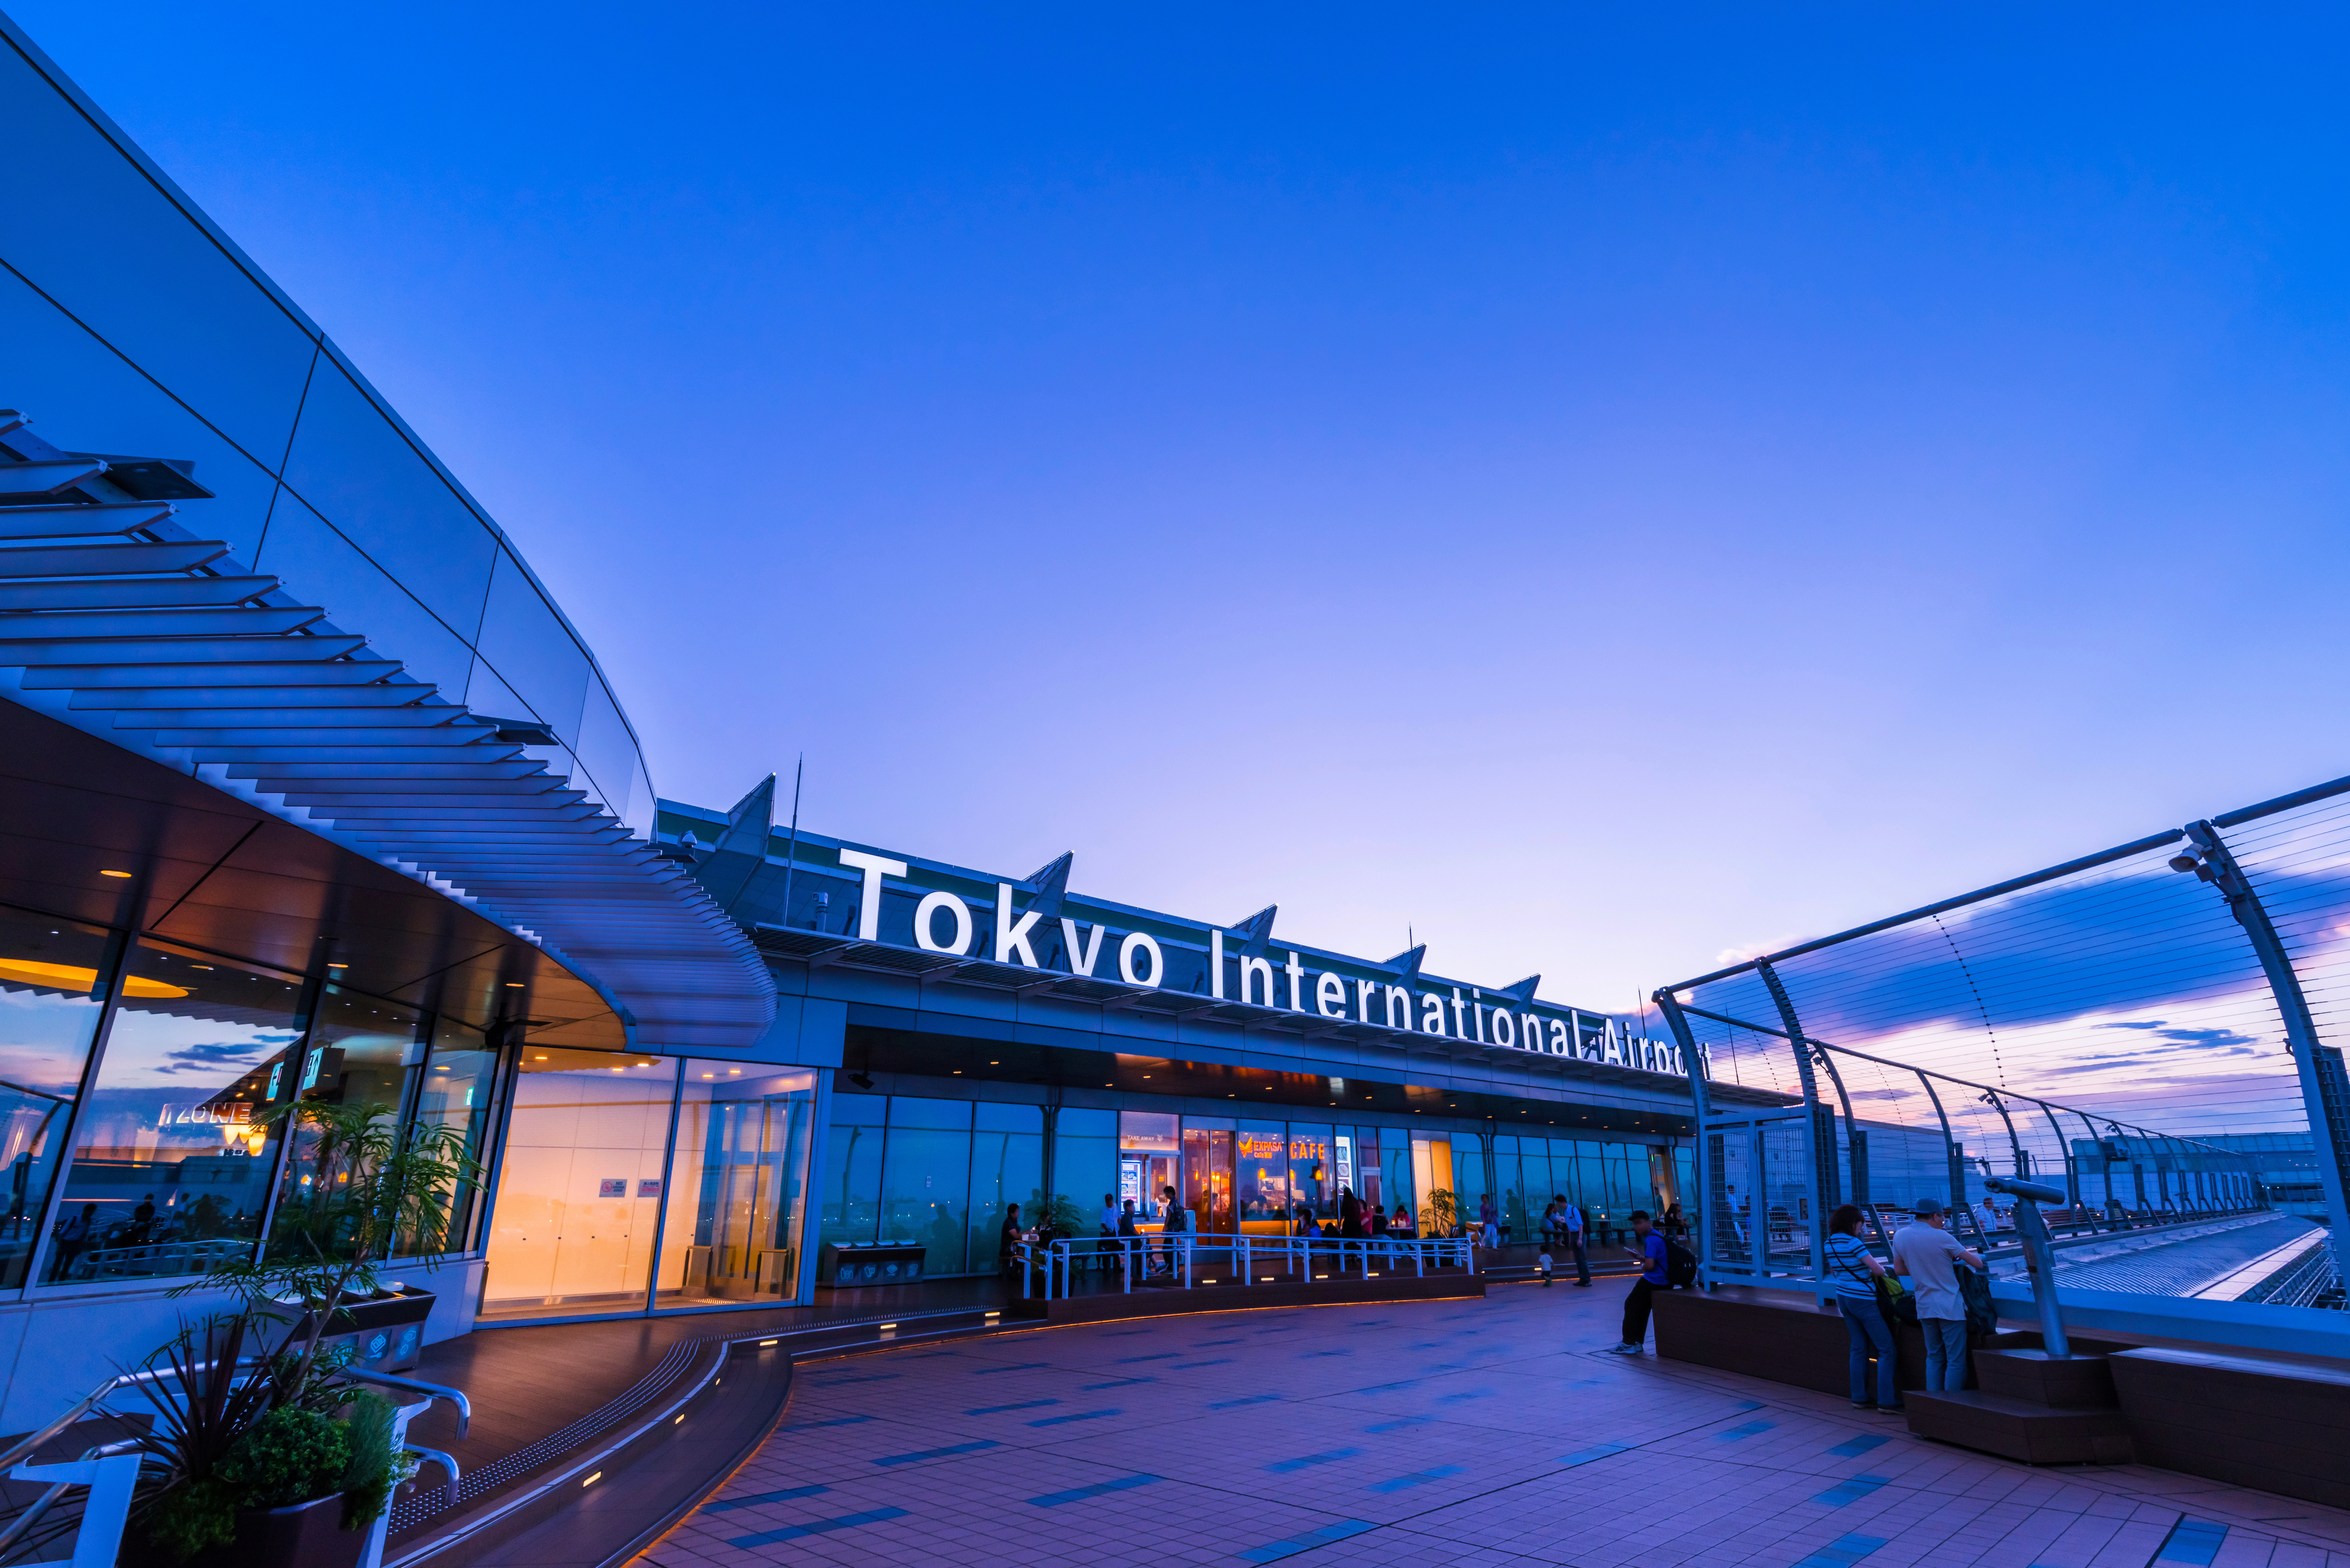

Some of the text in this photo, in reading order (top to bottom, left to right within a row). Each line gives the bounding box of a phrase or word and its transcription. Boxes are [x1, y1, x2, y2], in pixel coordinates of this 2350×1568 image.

[838, 847, 1715, 1081] Tokyo International Airpot
[1253, 1141, 1282, 1152] EXPASA
[1290, 1142, 1325, 1160] CAFE
